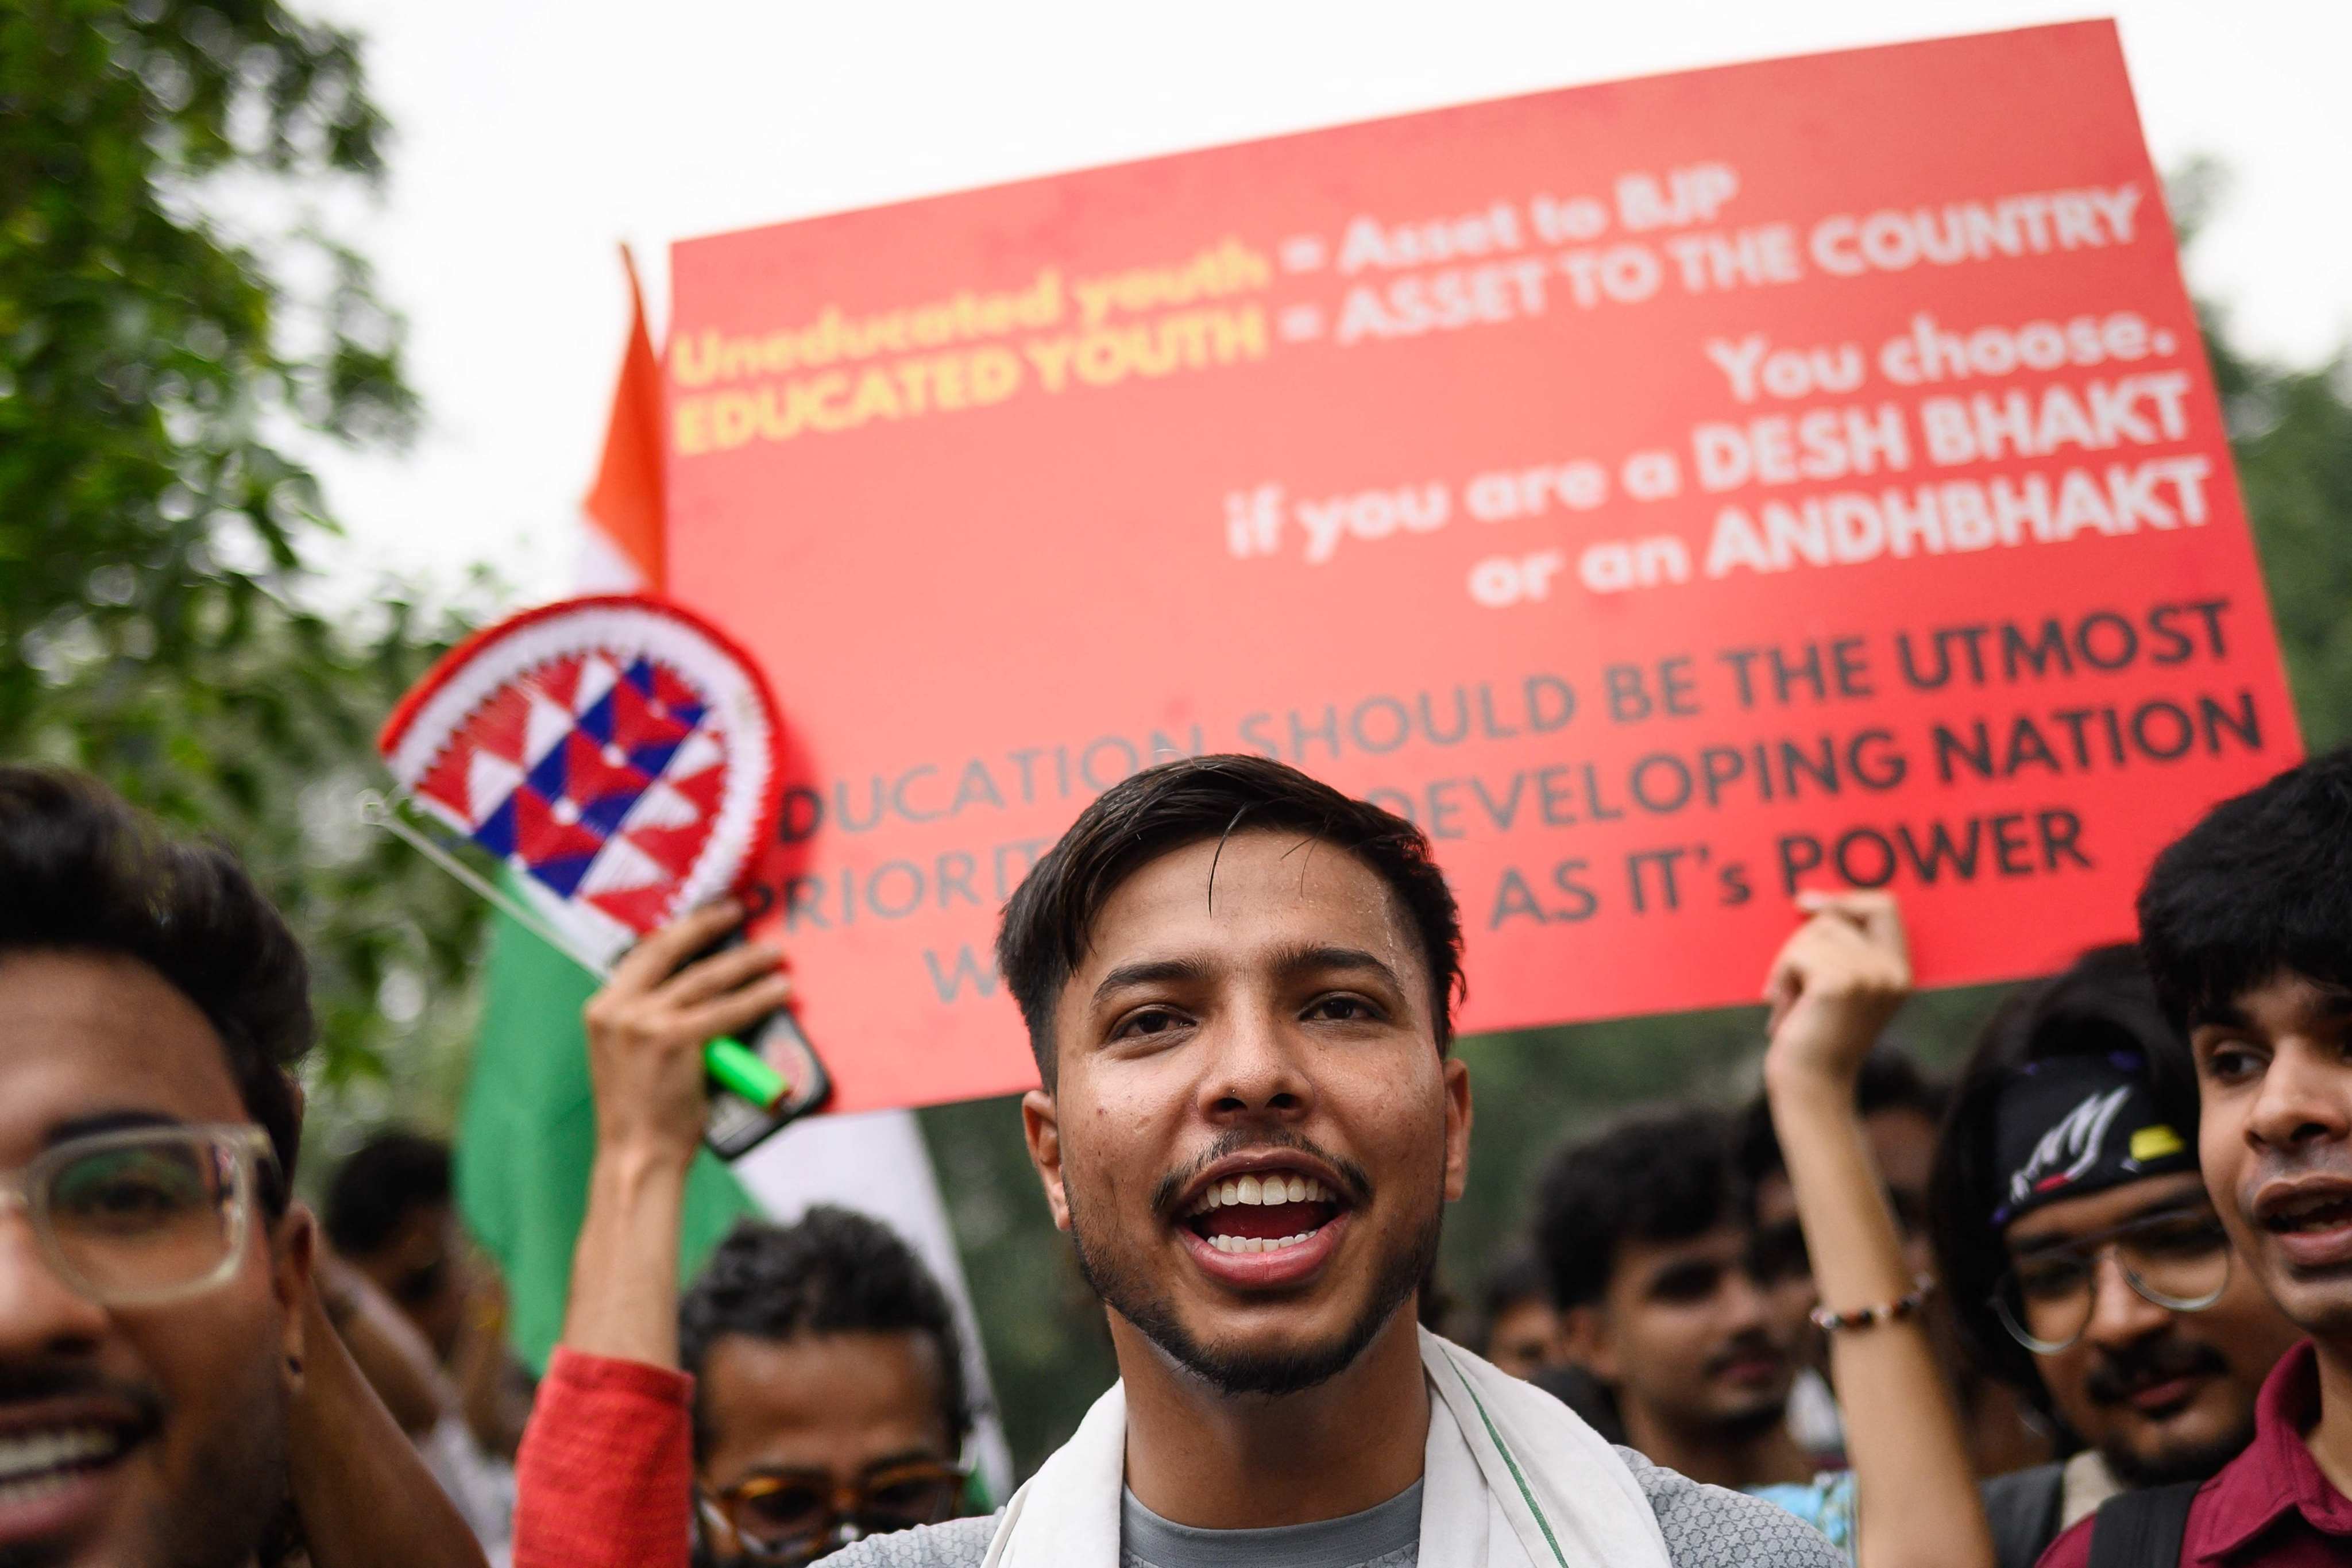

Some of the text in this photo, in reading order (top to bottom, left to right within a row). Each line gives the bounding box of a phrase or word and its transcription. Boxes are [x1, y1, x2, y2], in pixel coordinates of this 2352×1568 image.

[674, 271, 1063, 387] Uneducated
[1076, 237, 1270, 328] youth
[1338, 203, 1519, 274] Asset
[1531, 195, 1605, 244] to
[1615, 163, 1738, 230] BJP
[676, 346, 1021, 455] EDUCATED
[1027, 304, 1269, 392] YOUTH
[1336, 259, 1545, 345] ASSET
[1559, 245, 1659, 310] TO
[1672, 223, 1801, 293] THE
[1810, 183, 2141, 276] COUNTRY
[1704, 311, 2175, 403] You choose.
[1225, 369, 2189, 565] if you are a DESH BHAKT
[1469, 455, 2211, 608] or an ANDHBHAKT
[779, 599, 2229, 844] DUCATION SHOULD BE THE UTMOST
[1934, 690, 2262, 782] NATION
[1489, 807, 2093, 931] AS IT's POWER
